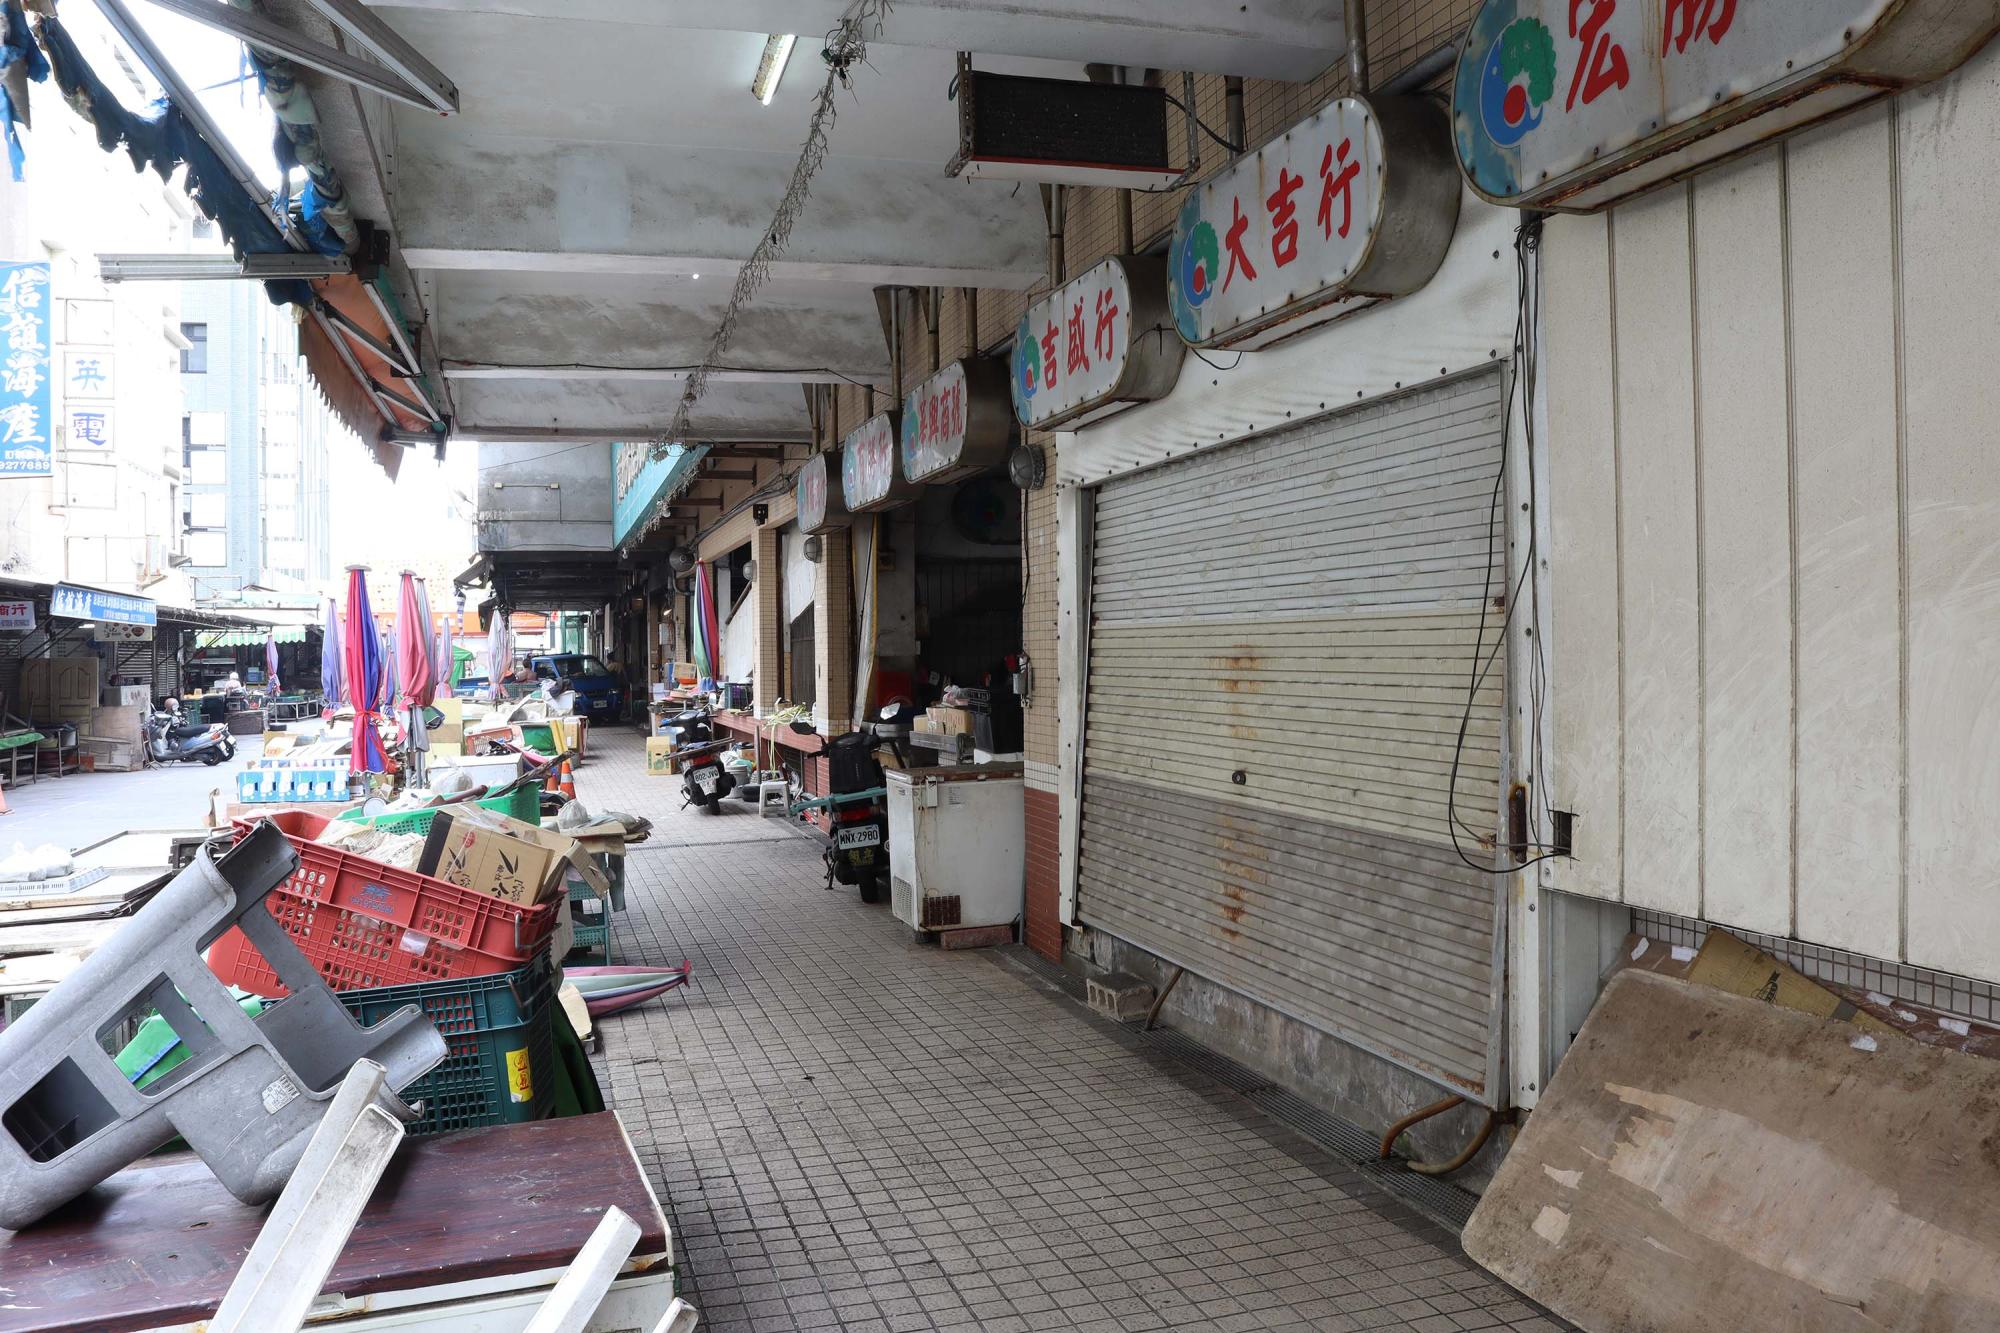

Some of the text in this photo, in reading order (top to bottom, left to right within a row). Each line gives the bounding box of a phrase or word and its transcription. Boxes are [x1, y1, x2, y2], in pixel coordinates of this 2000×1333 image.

[1565, 0, 1738, 115] 宏
[1222, 137, 1361, 295] 大吉行
[1040, 287, 1119, 391] 吉盛行
